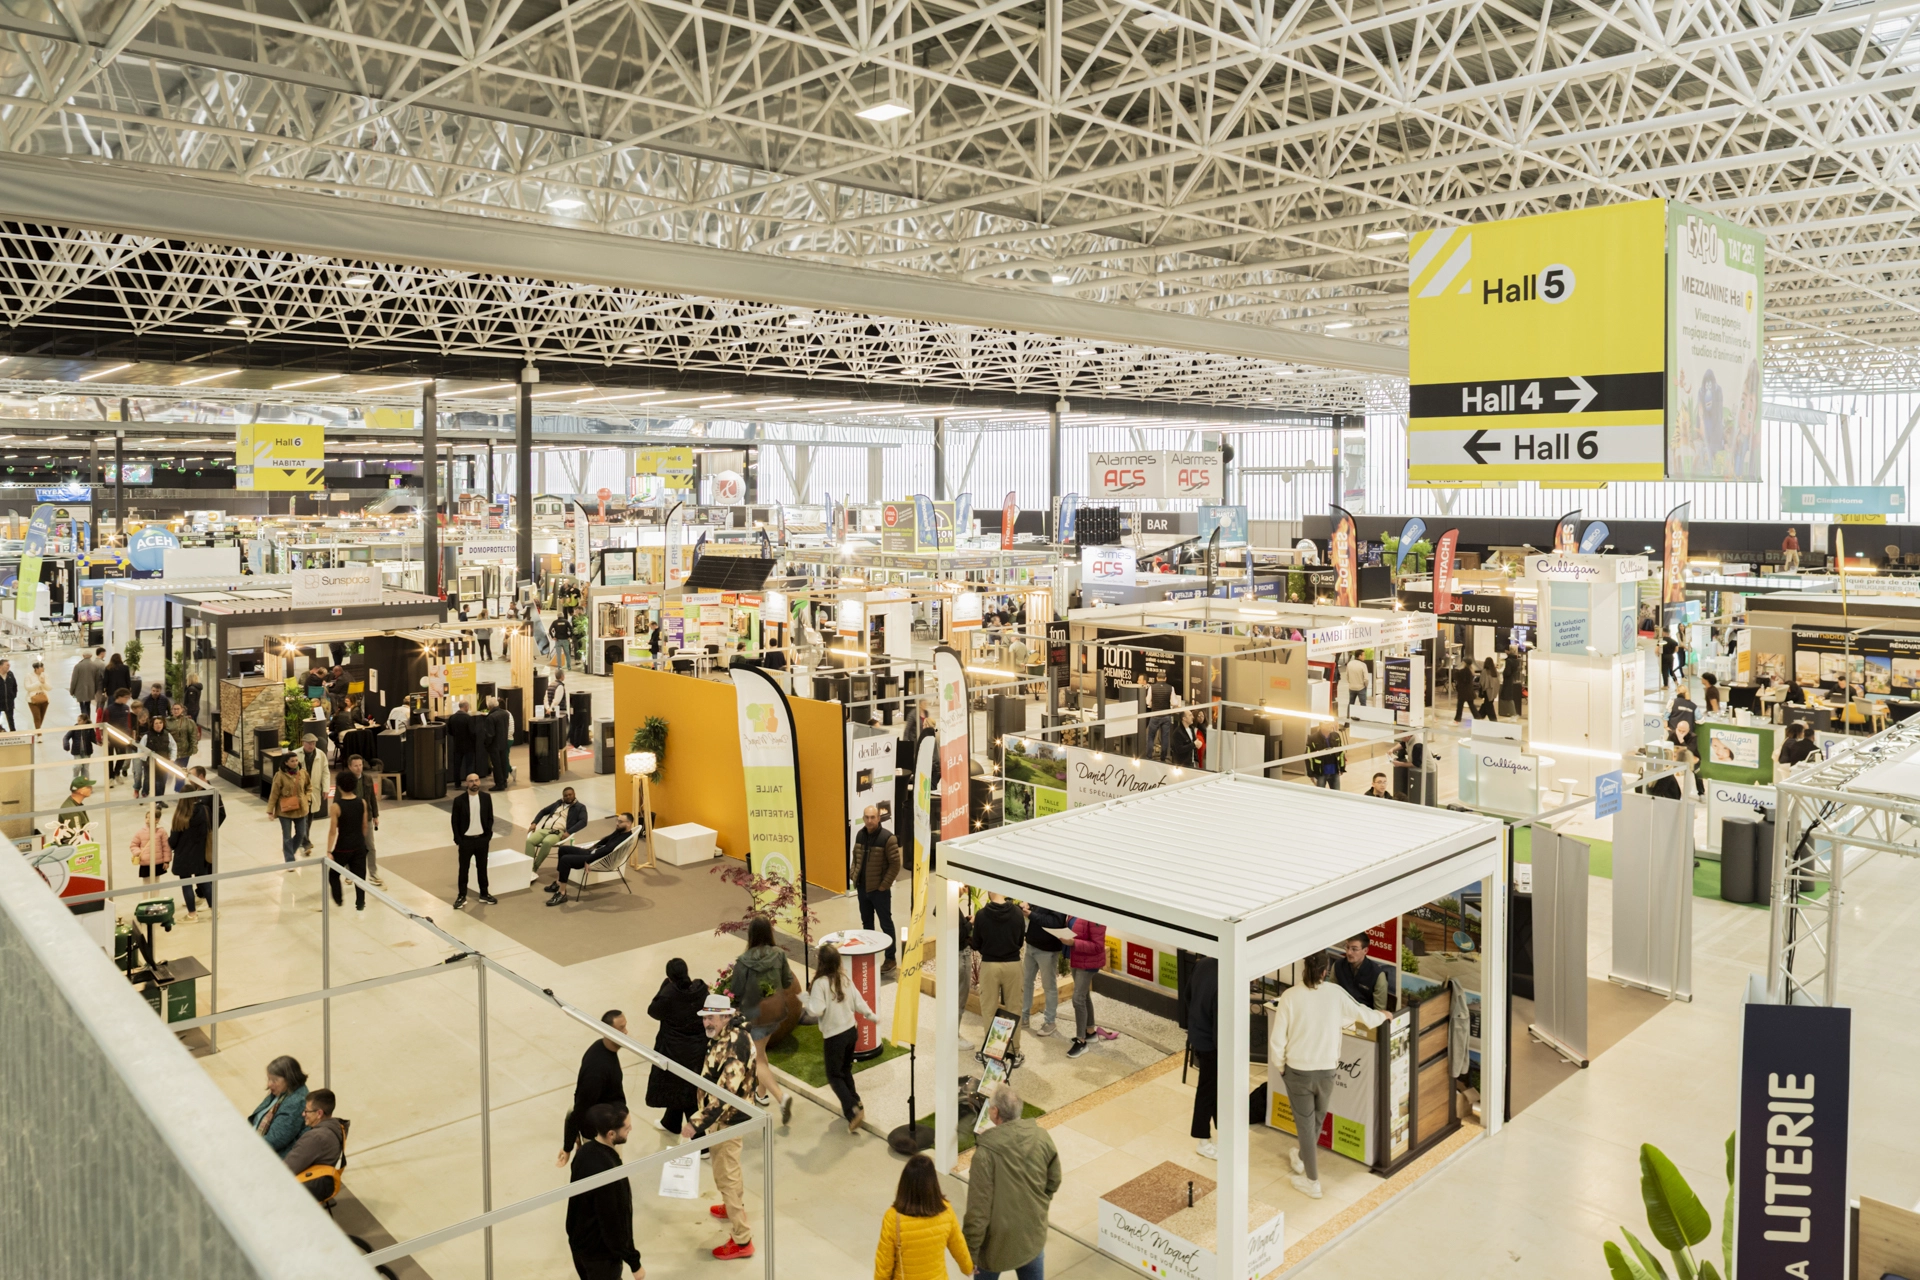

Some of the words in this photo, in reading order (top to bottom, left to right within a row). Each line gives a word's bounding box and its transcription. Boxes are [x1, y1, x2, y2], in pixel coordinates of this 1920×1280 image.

[1687, 214, 1718, 264] EXPO
[1727, 238, 1741, 262] TAT
[1483, 275, 1536, 305] Hall
[1544, 270, 1565, 299] 5
[1682, 275, 1728, 304] MEZZANINE
[1730, 289, 1744, 308] Hall
[1695, 307, 1710, 322] Vivez
[1711, 314, 1721, 326] une
[1682, 325, 1708, 342] magique
[1709, 328, 1721, 342] dans
[1692, 345, 1712, 358] studios
[1462, 384, 1515, 413] Hall
[1520, 381, 1544, 411] 4
[276, 438, 293, 446] Hall
[294, 438, 301, 447] 6
[1514, 433, 1570, 460] Hall
[1577, 431, 1599, 460] 6
[1096, 454, 1157, 466] Alarmes
[1172, 453, 1218, 466] Alarmes
[1104, 469, 1146, 487] ACS
[1178, 469, 1210, 486] ACS
[1147, 520, 1168, 531] BAR
[137, 536, 173, 550] ACEH
[469, 546, 516, 554] DOMOPROTECTIO
[1438, 538, 1451, 589] HITACHI
[1766, 552, 1824, 562] DRAERIE
[1092, 561, 1124, 575] ACS
[1537, 560, 1600, 579] Culligan
[1620, 560, 1645, 579] Culligan
[322, 576, 370, 586] Sunspace
[1828, 577, 1864, 586] Fabiqué
[1900, 578, 1916, 586] che
[1428, 602, 1464, 612] CORT
[1465, 604, 1476, 613] DU
[1477, 605, 1491, 613] FEU
[1562, 618, 1586, 627] solution
[1559, 626, 1581, 634] durable
[1562, 639, 1584, 647] calcaire
[1104, 667, 1132, 680] CHEMINÉES
[1386, 695, 1410, 704] PRIMES
[1716, 731, 1752, 746] Culligan
[858, 742, 882, 759] deville
[1483, 756, 1532, 774] Culligan
[1076, 762, 1114, 786] Daniel
[1115, 769, 1167, 793] Moquet
[1044, 798, 1059, 806] TAILLE
[1716, 790, 1773, 808] Culliga
[1369, 938, 1393, 951] RASSE
[1133, 951, 1147, 960] ALLÉE
[1134, 958, 1147, 966] COUR
[1130, 963, 1151, 975] TERRASSE
[1336, 1057, 1362, 1079] quet
[1279, 1102, 1291, 1110] PORTA
[1338, 1129, 1361, 1142] ENTRETIEN
[1342, 1125, 1357, 1134] TAILLE
[1339, 1136, 1360, 1148] CRÉATION
[1764, 1072, 1815, 1243] LITERIE
[1114, 1213, 1150, 1242] Daniel
[1150, 1231, 1200, 1272] Moquet
[1110, 1231, 1148, 1256] SPÉCIALISTE
[1150, 1253, 1158, 1261] DE
[1160, 1259, 1173, 1269] VOS
[1175, 1266, 1201, 1280] EXTÉRIE
